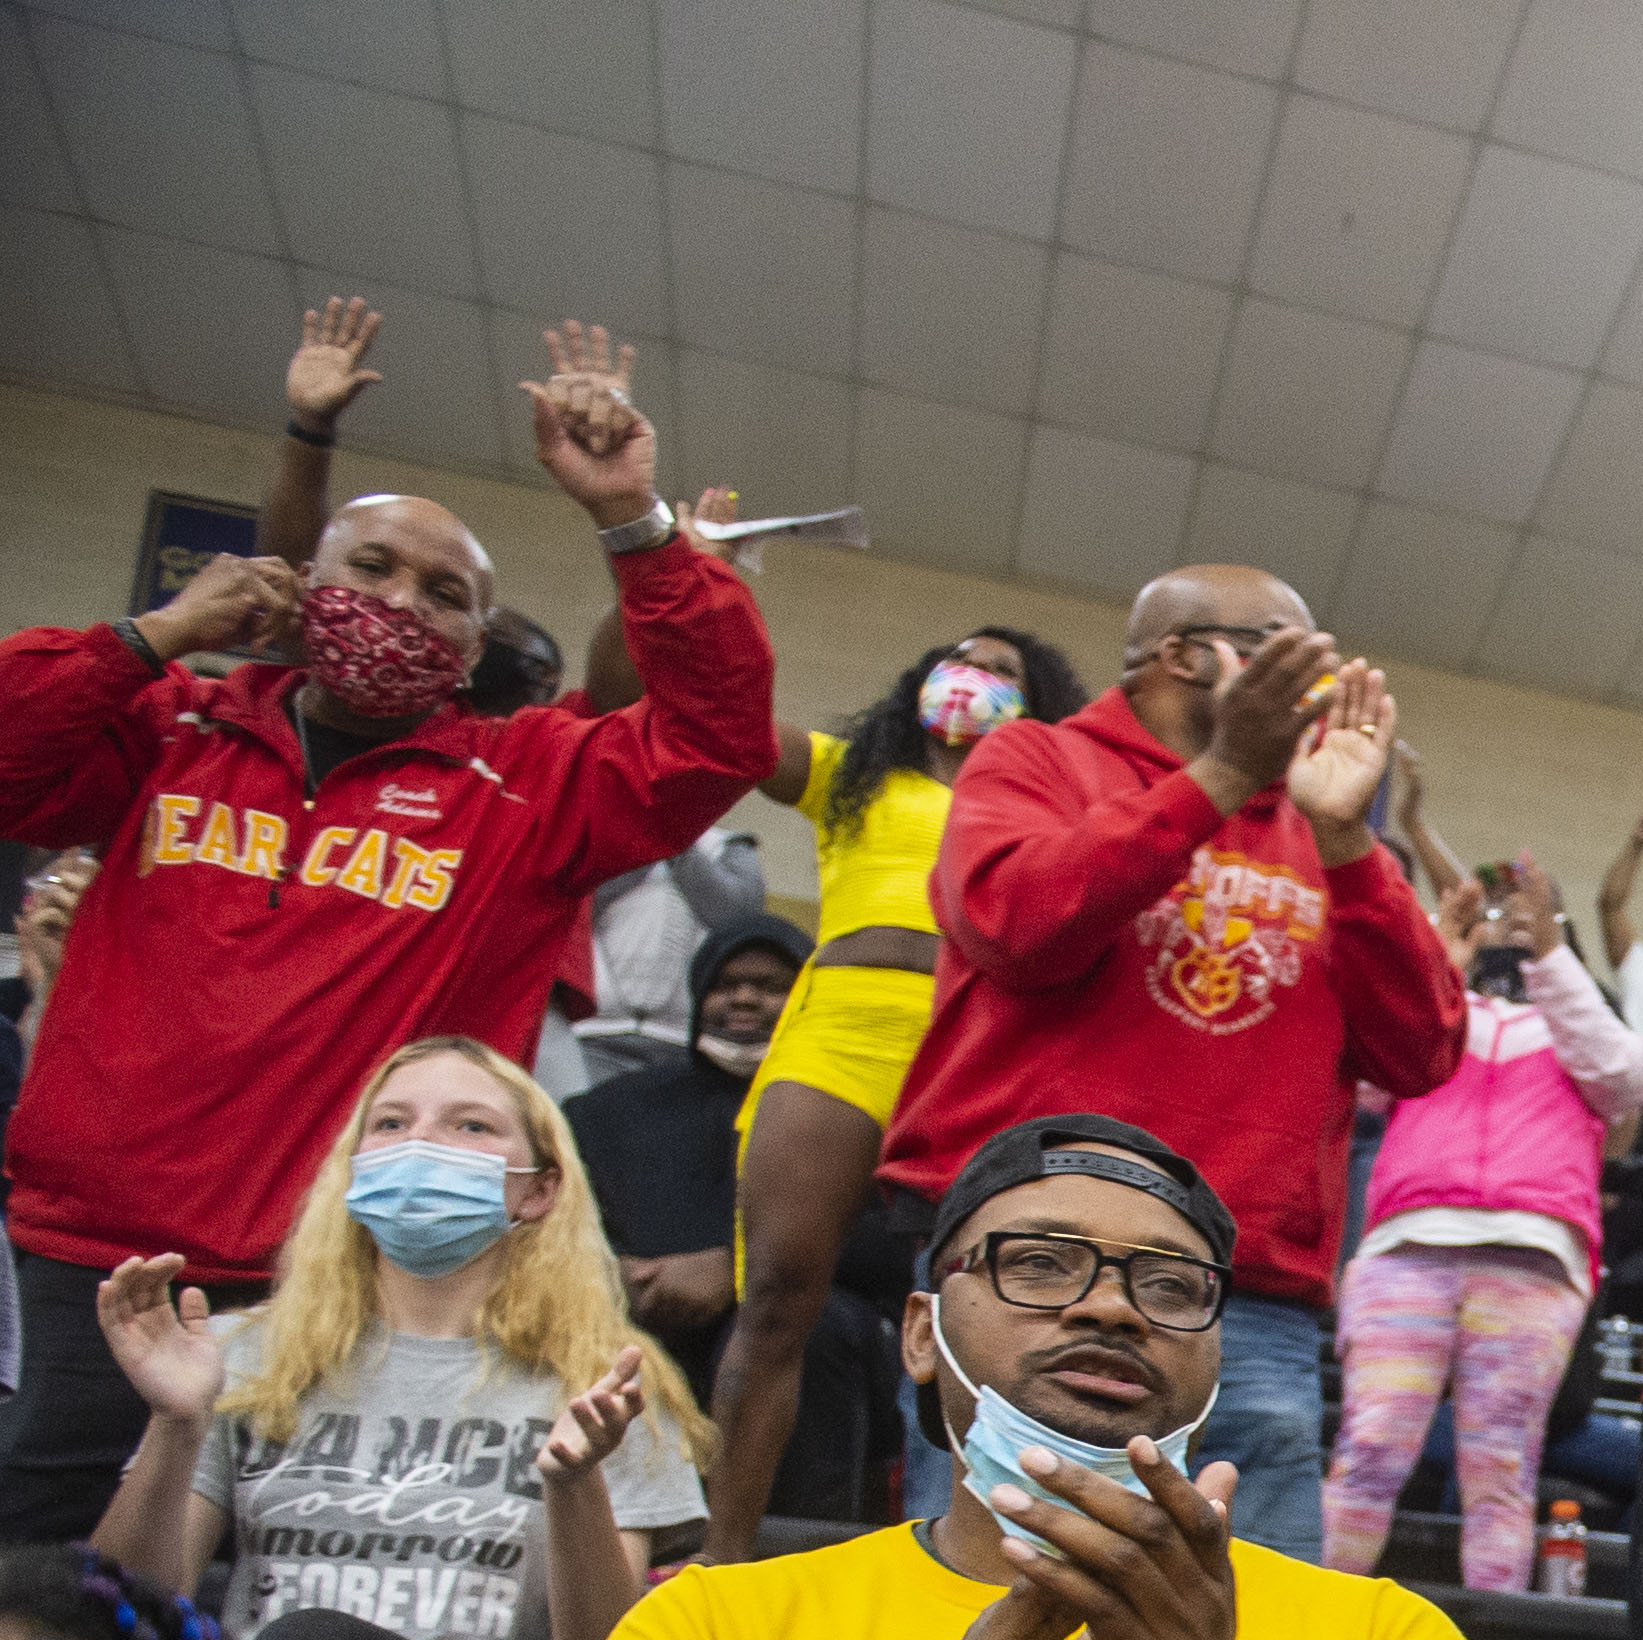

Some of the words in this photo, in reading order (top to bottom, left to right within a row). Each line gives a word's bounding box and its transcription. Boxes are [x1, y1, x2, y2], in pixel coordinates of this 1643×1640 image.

[300, 825, 465, 914] CATS
[238, 1458, 533, 1546] Today
[264, 1562, 520, 1638] FOREVER
